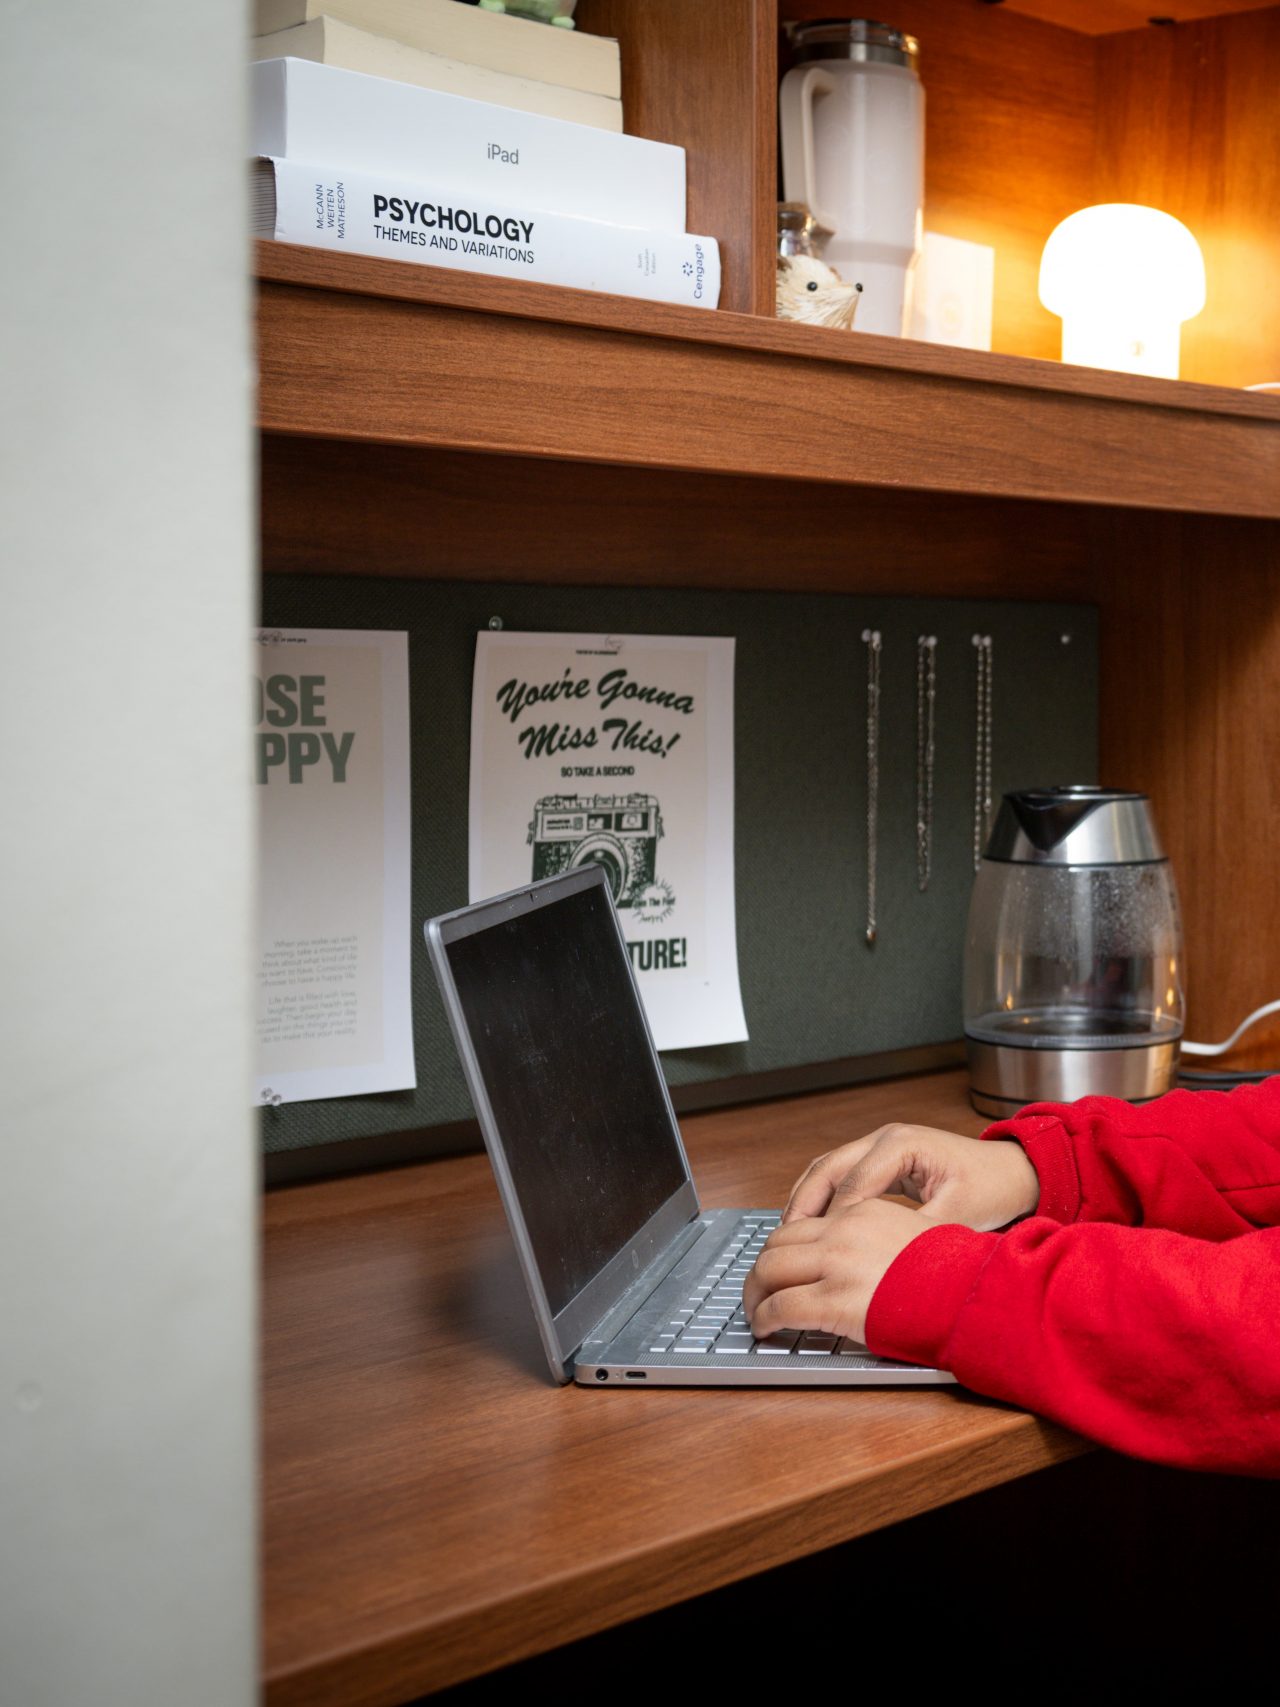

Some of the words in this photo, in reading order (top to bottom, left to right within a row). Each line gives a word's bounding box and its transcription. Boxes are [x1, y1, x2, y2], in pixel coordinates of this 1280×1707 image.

[487, 142, 519, 165] iPad
[315, 184, 324, 229] McCANN
[327, 188, 335, 228] WEITEN
[336, 181, 345, 239] MATHESON
[373, 194, 534, 244] PSYCHOLOGY
[373, 225, 426, 246] THEMES
[429, 235, 458, 251] AND
[461, 240, 534, 264] VARIATIONS
[694, 243, 705, 299] Cengage
[496, 667, 590, 723] You're
[597, 668, 694, 714] Gonna
[518, 723, 598, 759] Miss
[602, 718, 681, 759] This!
[561, 767, 573, 778] SO
[575, 766, 594, 777] TAKE
[596, 766, 602, 776] A
[603, 765, 635, 777] SECOND
